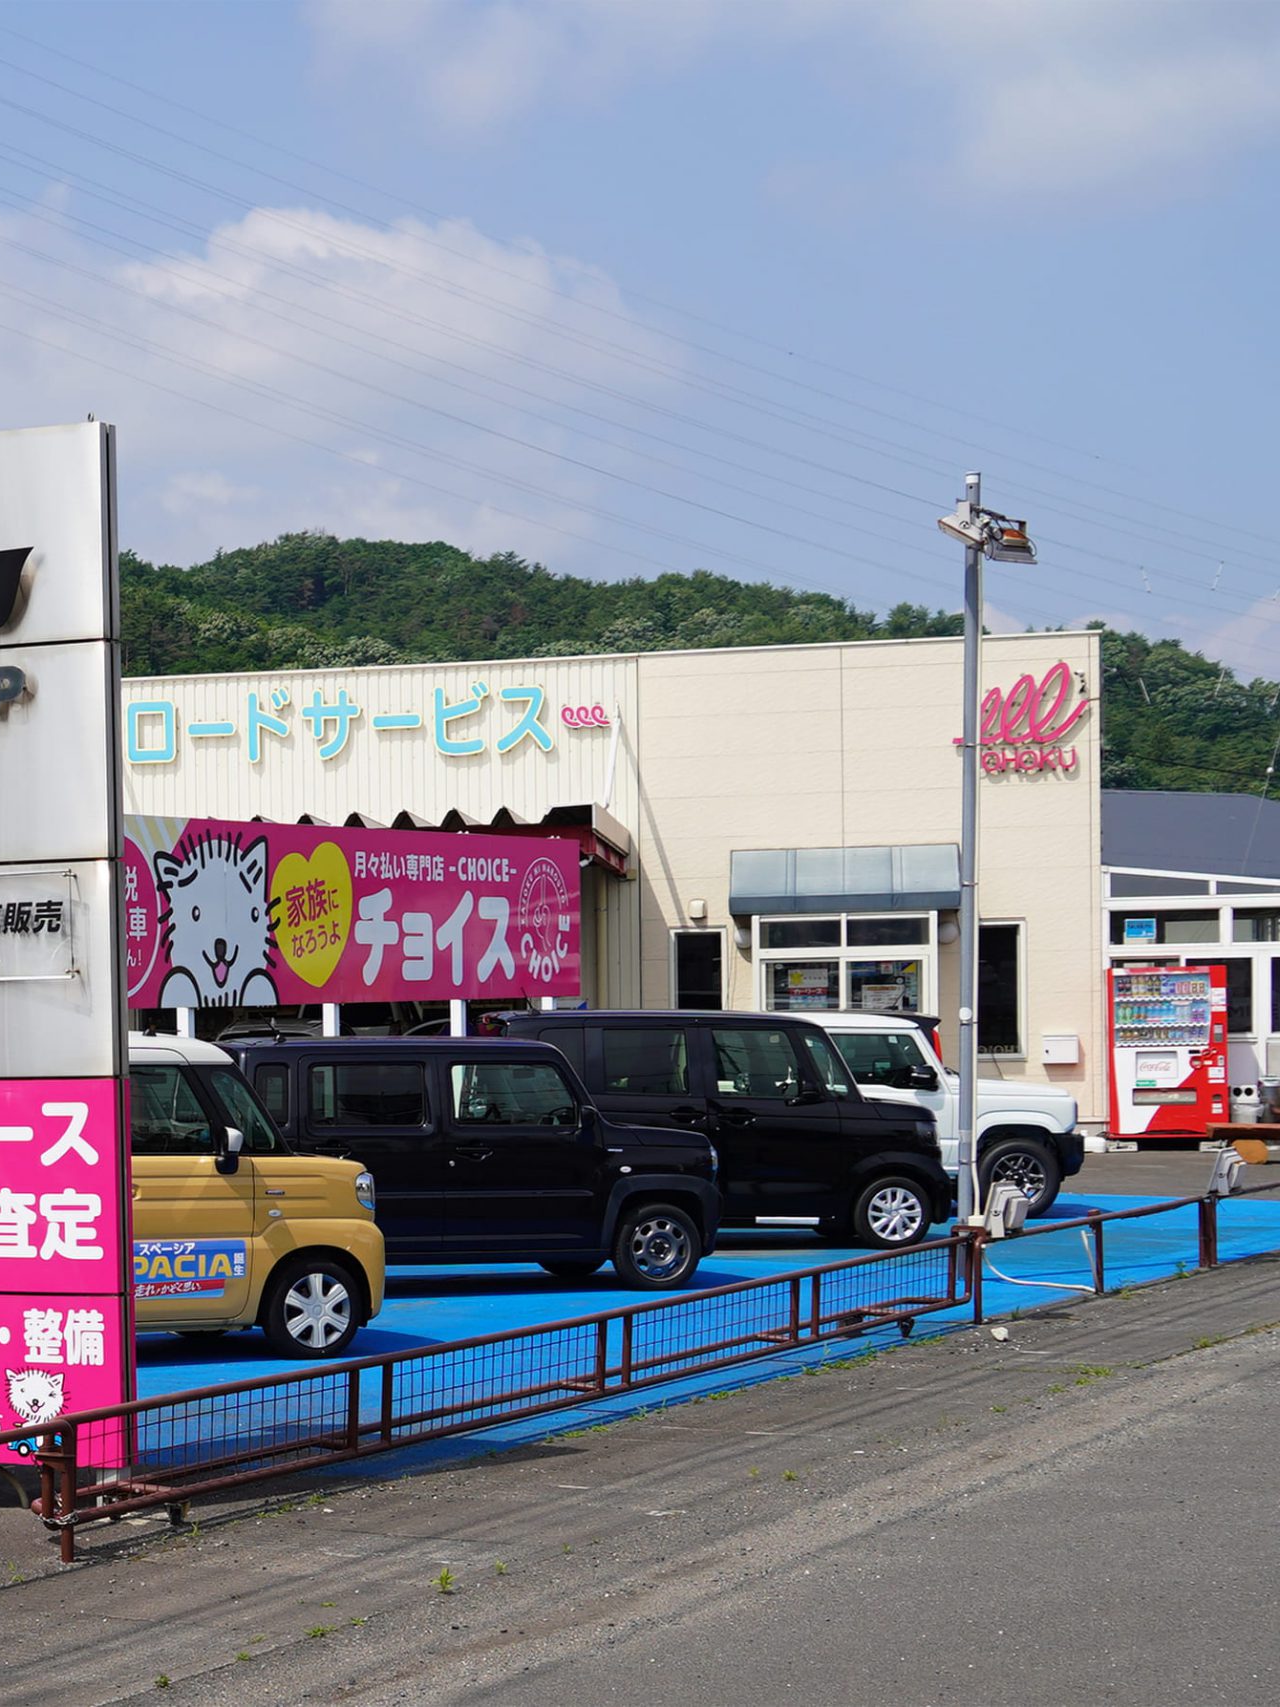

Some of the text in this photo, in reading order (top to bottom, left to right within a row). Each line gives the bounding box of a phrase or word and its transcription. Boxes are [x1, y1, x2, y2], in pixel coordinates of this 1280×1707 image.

[126, 681, 554, 763] ロードサービス
[980, 746, 1077, 772] OHOKU
[354, 850, 445, 882] 月々払い専門店
[285, 878, 339, 928] 家族に
[291, 920, 341, 959] なろうよ
[354, 887, 516, 987] チョイス
[139, 1242, 196, 1256] スペーシア
